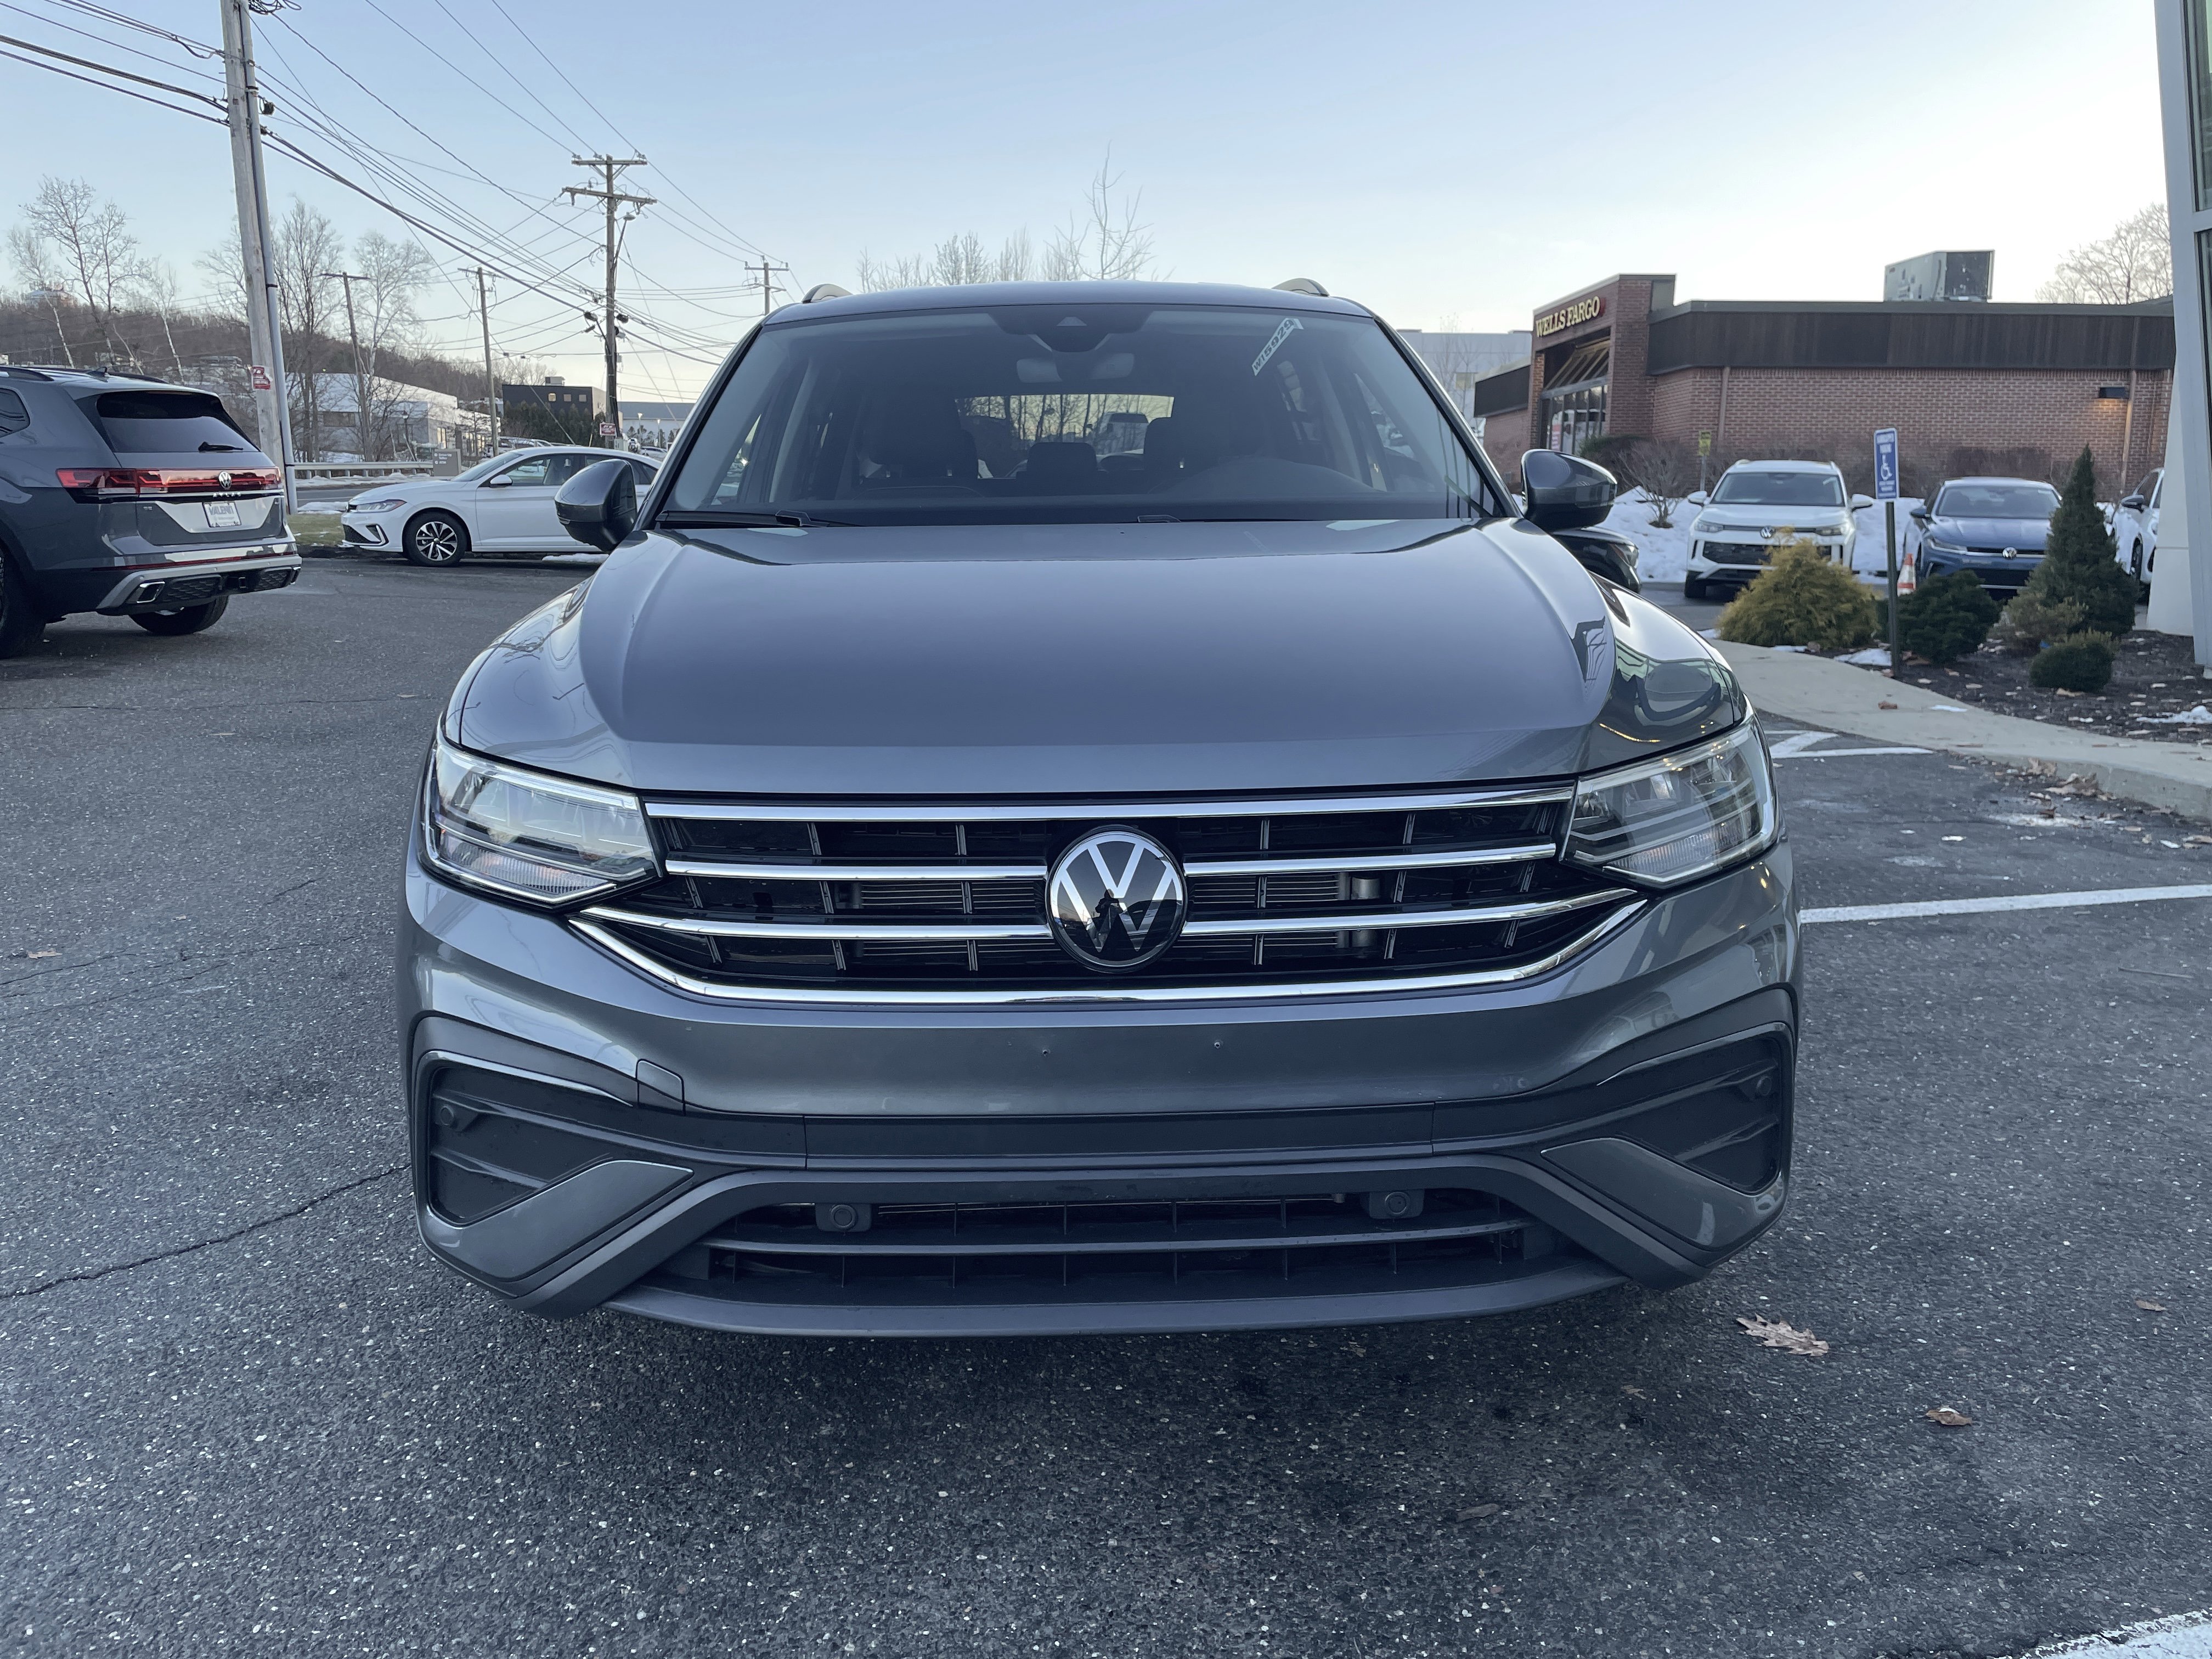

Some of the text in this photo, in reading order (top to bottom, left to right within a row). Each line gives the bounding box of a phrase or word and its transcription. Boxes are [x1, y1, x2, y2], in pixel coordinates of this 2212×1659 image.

[1536, 296, 1600, 337] WELLS FARGO
[1254, 320, 1294, 370] W15929
[219, 471, 231, 488] VW
[1050, 832, 1182, 966] VW
